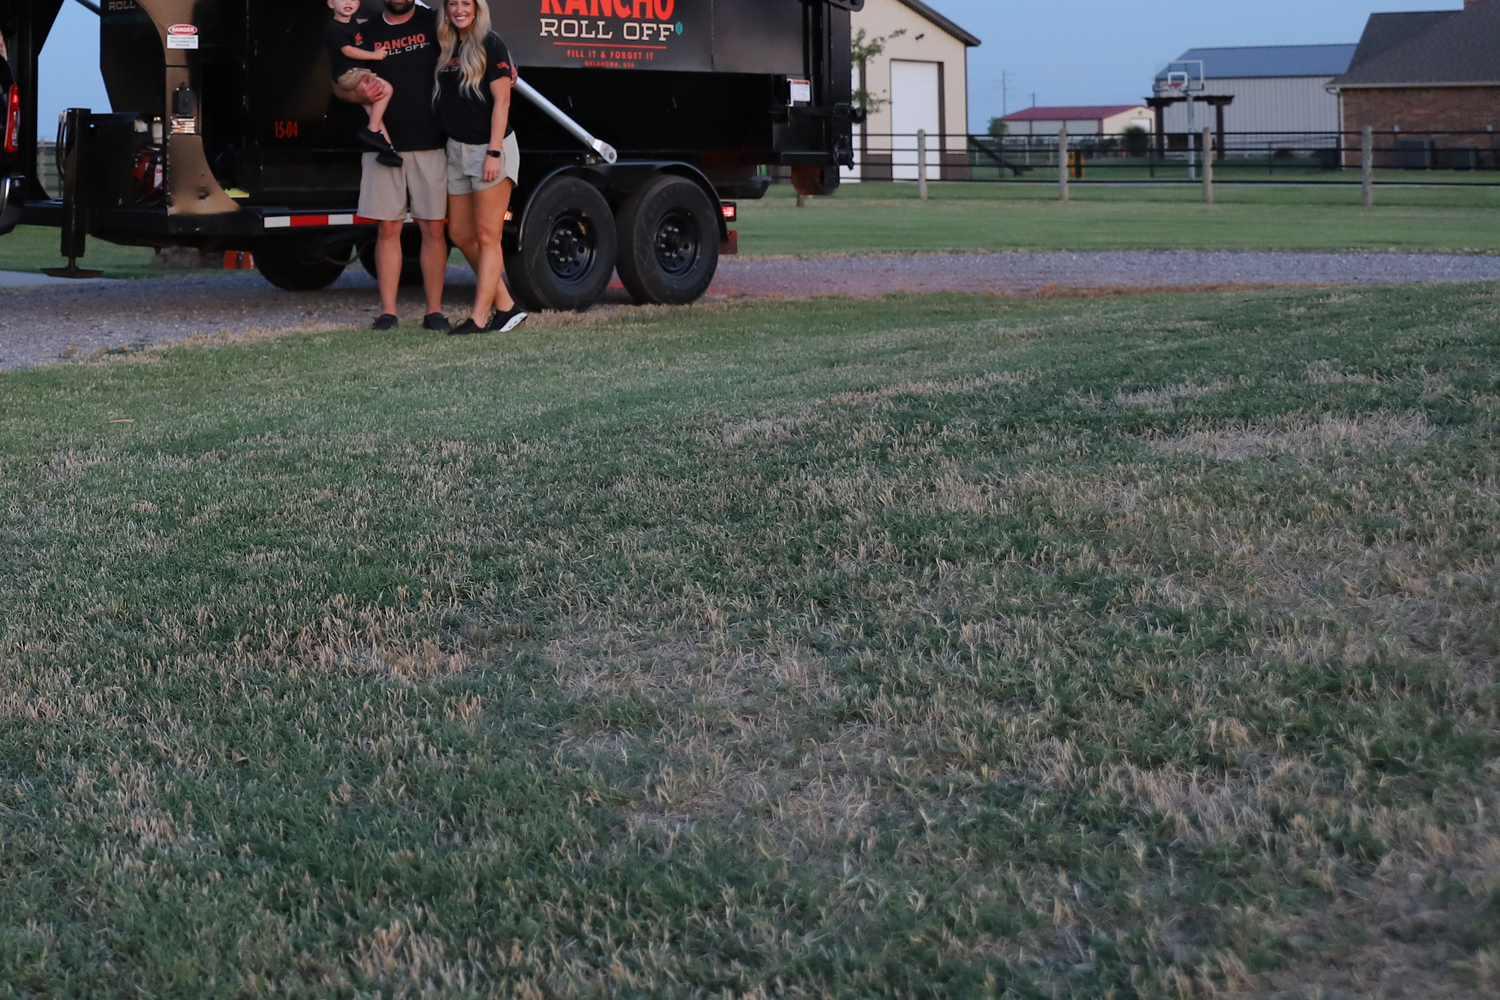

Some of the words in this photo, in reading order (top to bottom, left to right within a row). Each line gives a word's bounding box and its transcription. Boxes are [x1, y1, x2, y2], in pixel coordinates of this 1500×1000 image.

[108, 1, 136, 10] ROLL
[540, 18, 613, 39] ROLL
[623, 22, 674, 41] OFF
[374, 33, 426, 51] RANCHO
[566, 49, 585, 58] FILL
[589, 50, 597, 58] IT
[610, 51, 642, 60] FORGET
[646, 52, 654, 60] IT
[274, 120, 298, 138] 15-04
